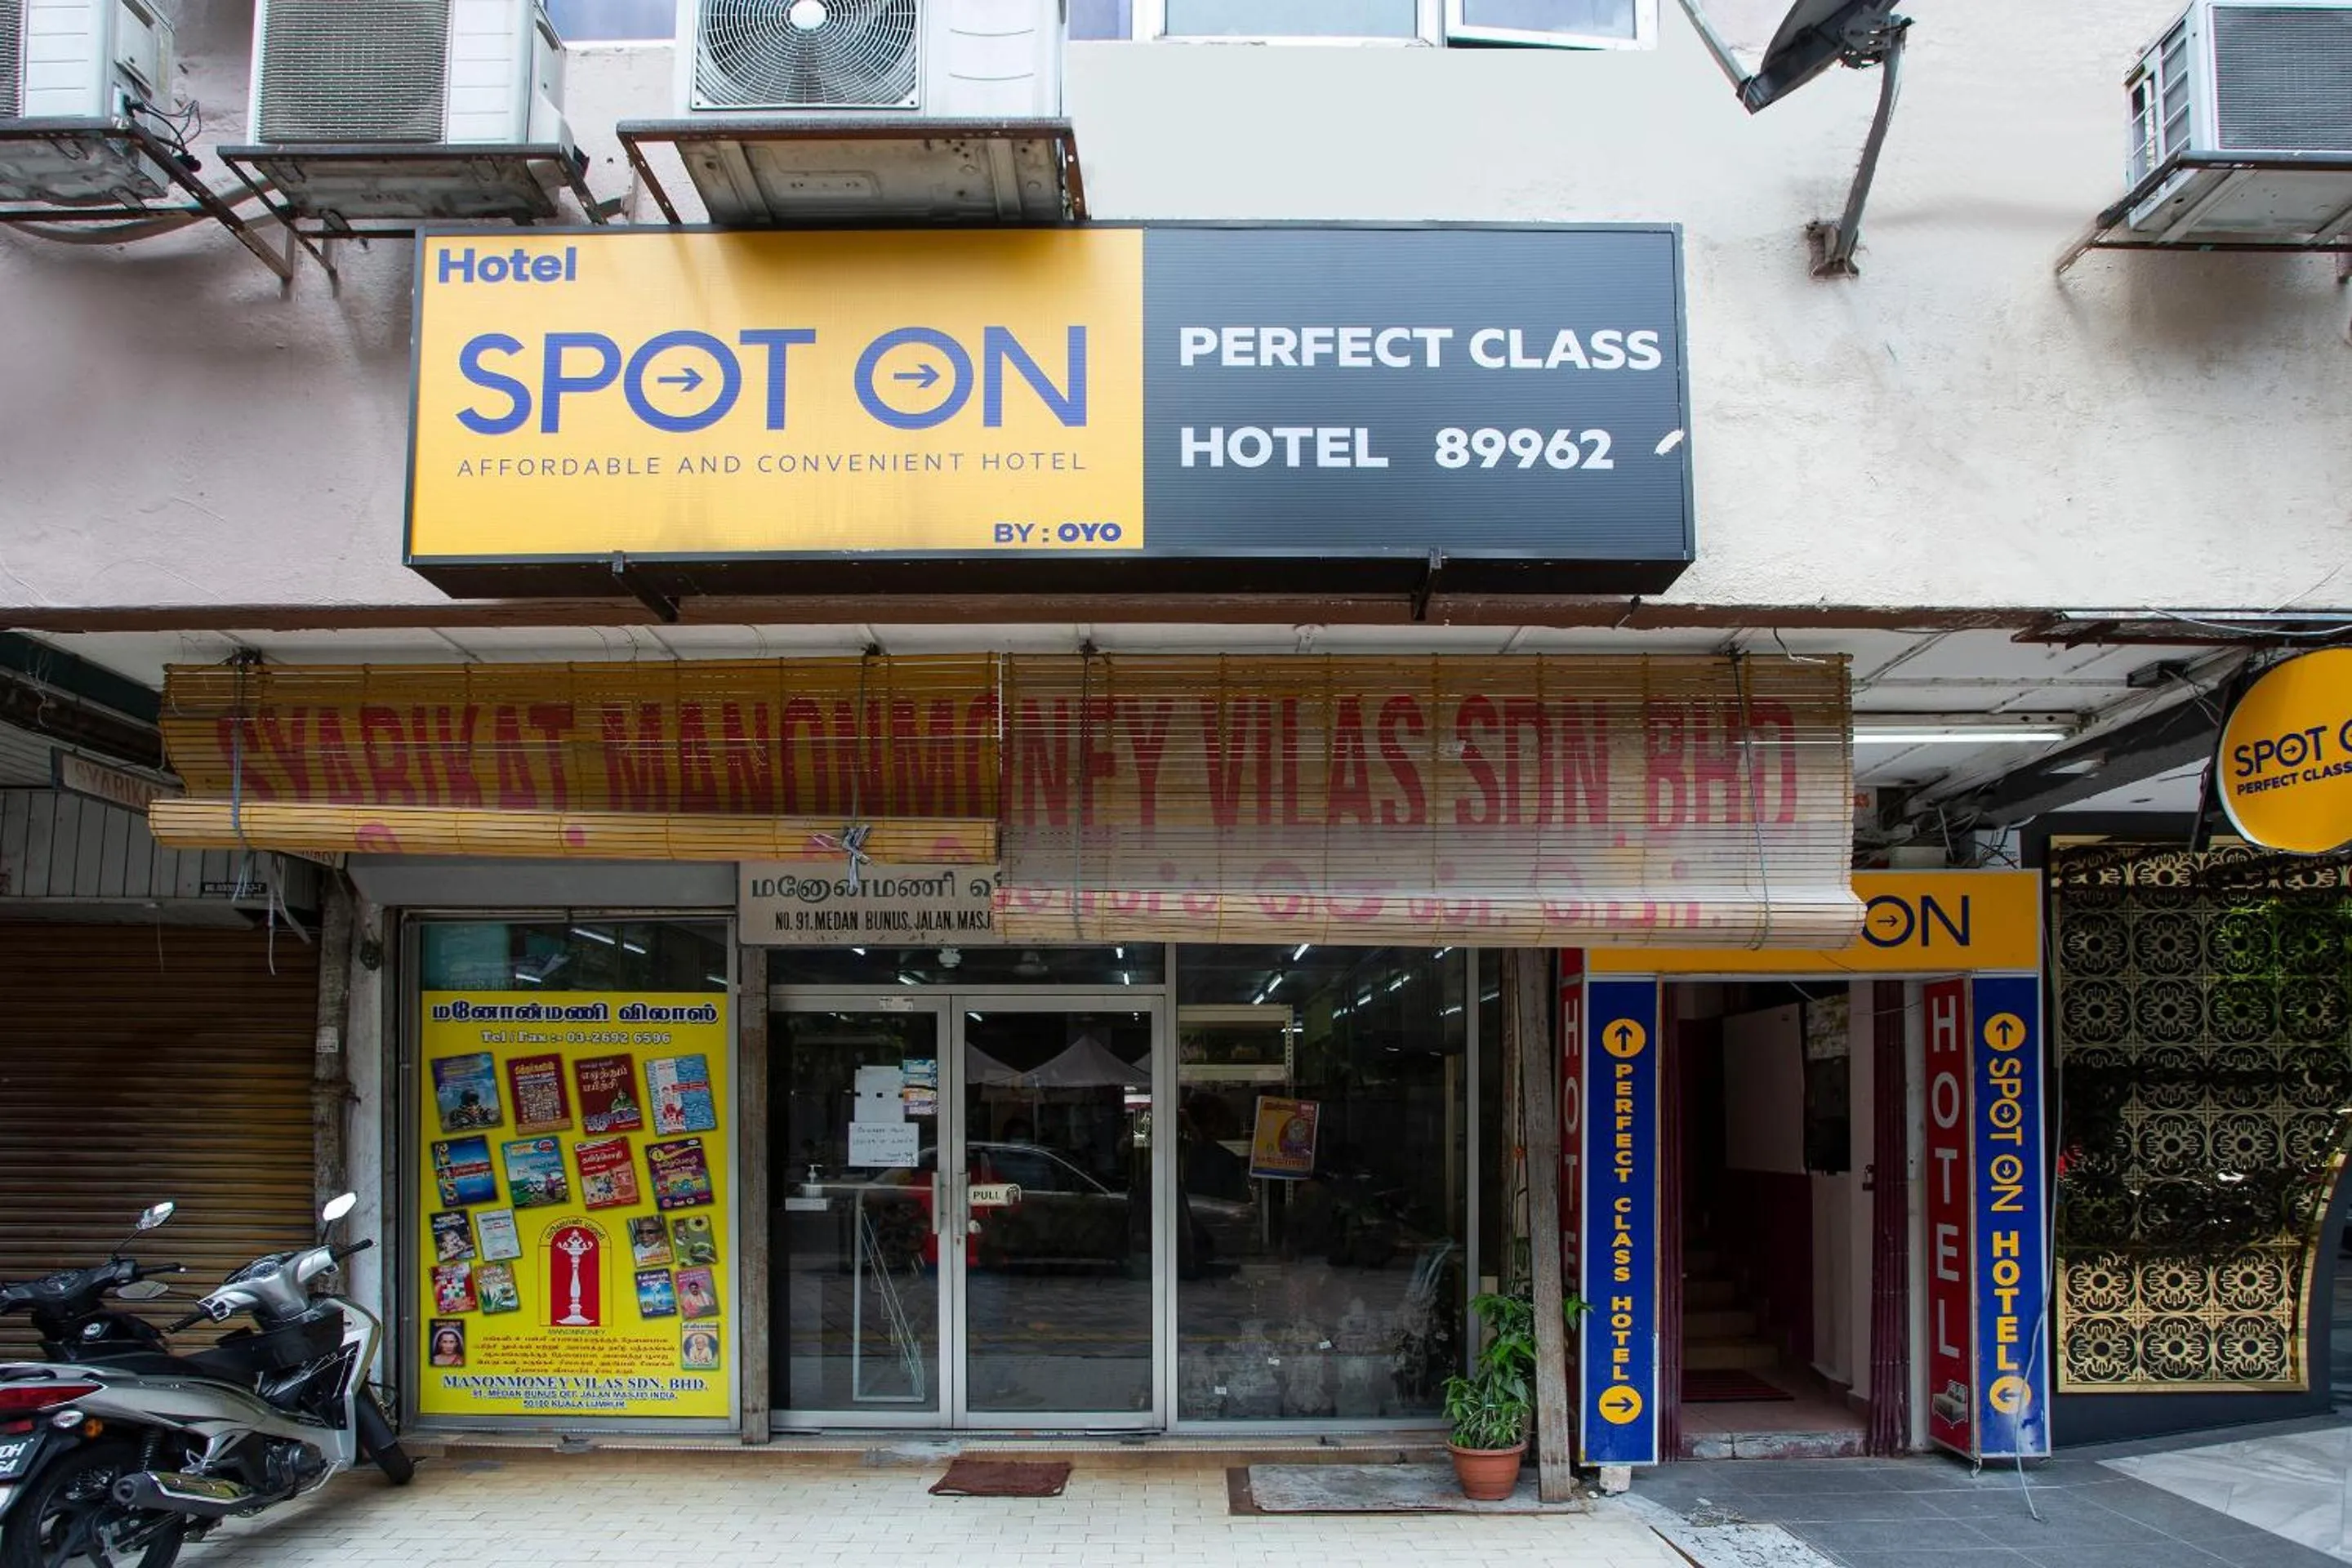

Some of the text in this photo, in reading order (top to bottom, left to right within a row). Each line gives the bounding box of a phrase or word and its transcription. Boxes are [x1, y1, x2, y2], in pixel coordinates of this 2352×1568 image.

[438, 247, 577, 283] Hotel
[1179, 327, 1663, 370] PERFECT CLASS
[456, 326, 1088, 435] SPOT ON
[457, 452, 1086, 477] AFFORDABLE AND CONVENIENT HOTEL
[1180, 426, 1615, 470] HOTEL 89962
[1057, 522, 1122, 544] OYO
[1199, 693, 1428, 827] VILAS
[2234, 725, 2328, 777] SPOT
[2236, 772, 2298, 796] PERFECT
[814, 911, 858, 931] MEDAN
[957, 911, 991, 931] MASJ
[1861, 894, 1971, 948] ON
[481, 1031, 506, 1043] Tel
[1989, 1058, 2024, 1212] SPOT ON
[973, 1192, 1001, 1200] PULL
[1931, 995, 1960, 1359] HOTEL
[1611, 1063, 1633, 1381] PERFECT CLASS HOTEL
[1992, 1231, 2020, 1371] HOTEL
[573, 1377, 624, 1389] VILAS
